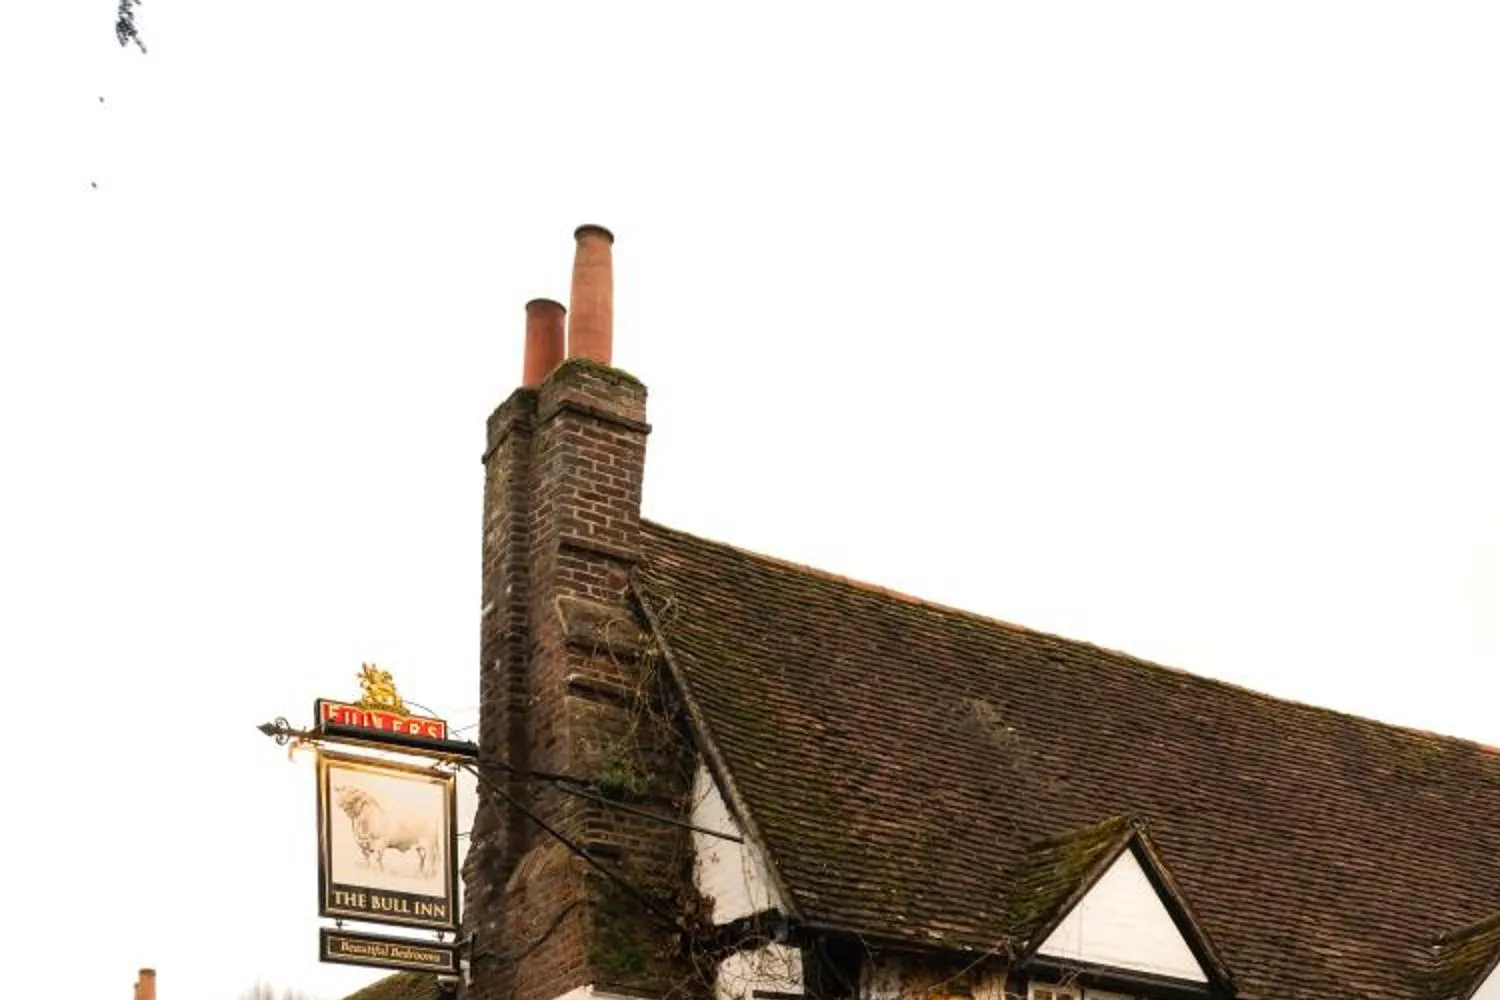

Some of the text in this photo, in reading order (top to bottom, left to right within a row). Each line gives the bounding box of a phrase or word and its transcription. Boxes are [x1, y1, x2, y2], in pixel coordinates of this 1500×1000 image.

[333, 891, 446, 917] THE BULL INN
[340, 940, 441, 963] Beautiful Bedrooms
